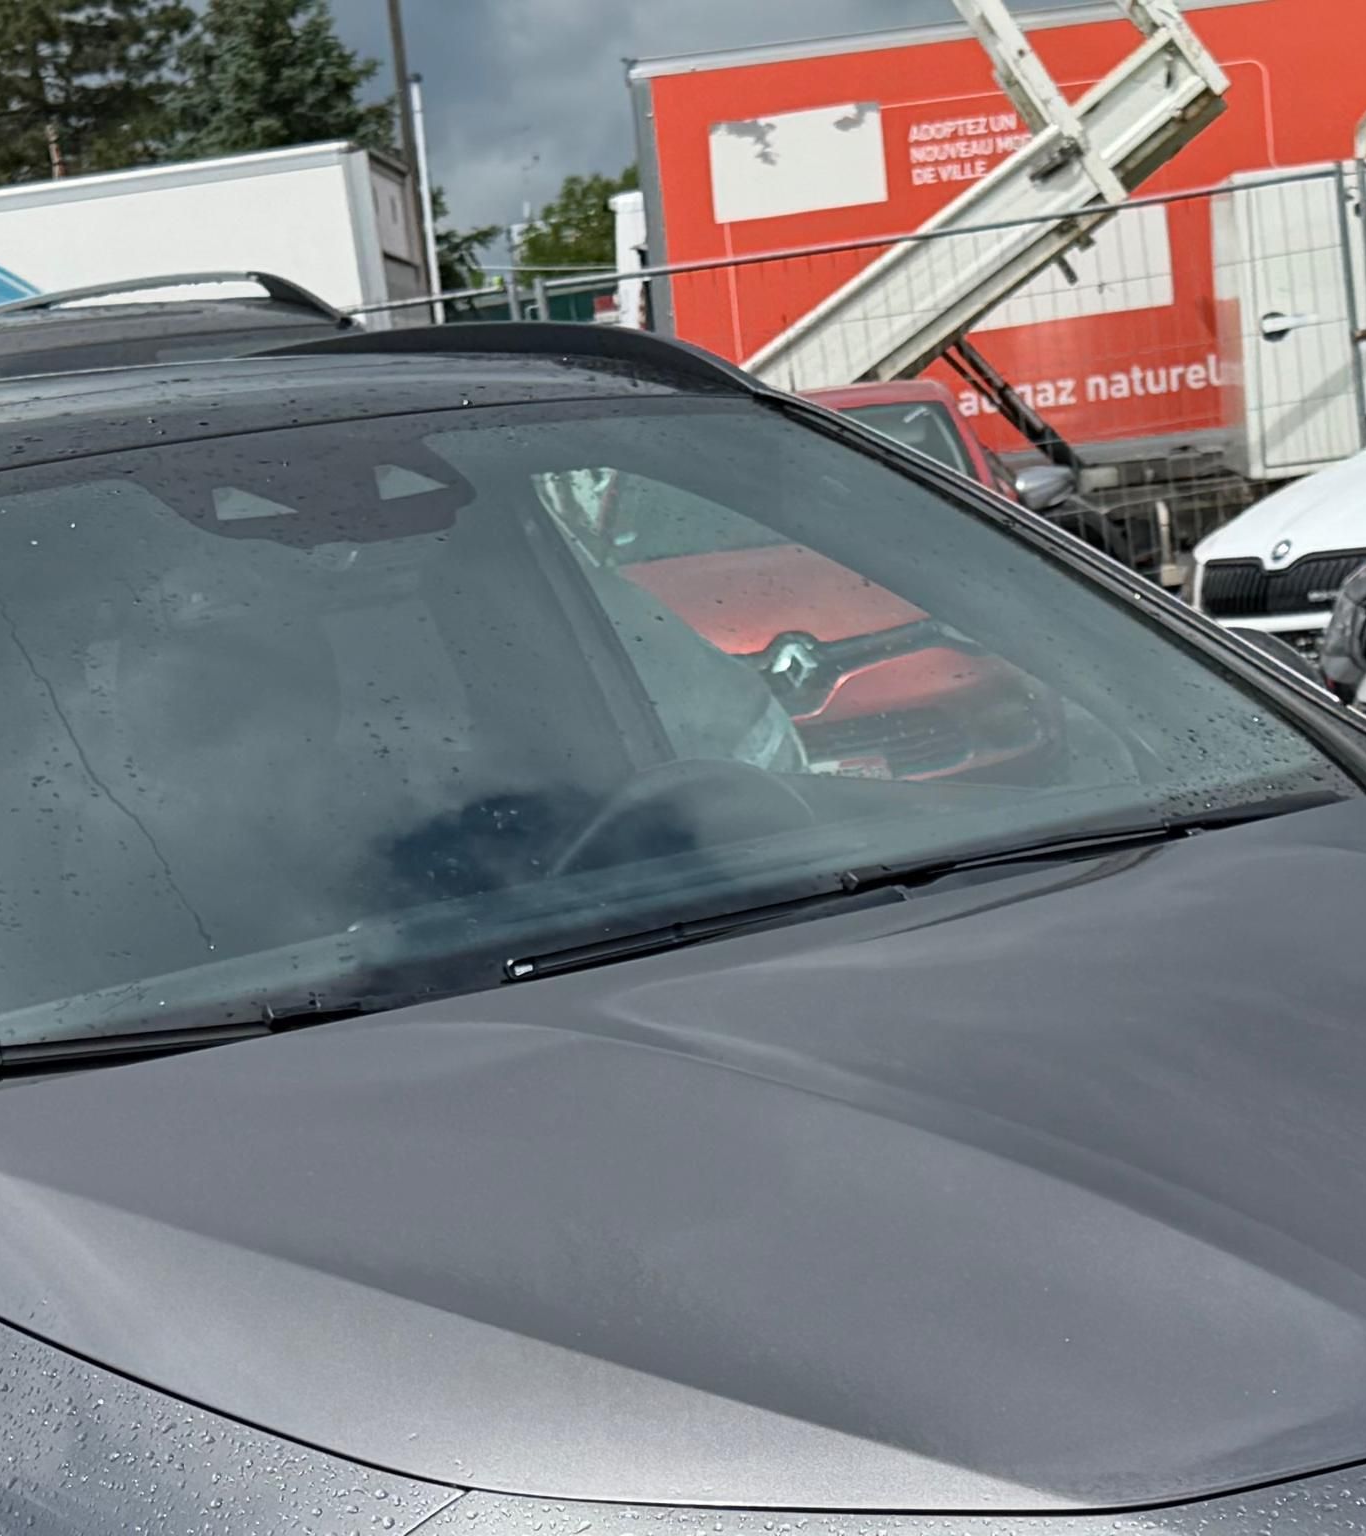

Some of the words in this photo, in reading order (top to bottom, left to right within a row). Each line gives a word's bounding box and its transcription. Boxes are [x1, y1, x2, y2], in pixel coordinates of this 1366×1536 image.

[908, 117, 988, 143] ADOPTEZ
[989, 113, 1017, 132] UN
[909, 137, 995, 164] NOUVEAU
[911, 167, 938, 186] DE
[938, 161, 988, 182] VILLE
[1086, 353, 1223, 402] naturel
